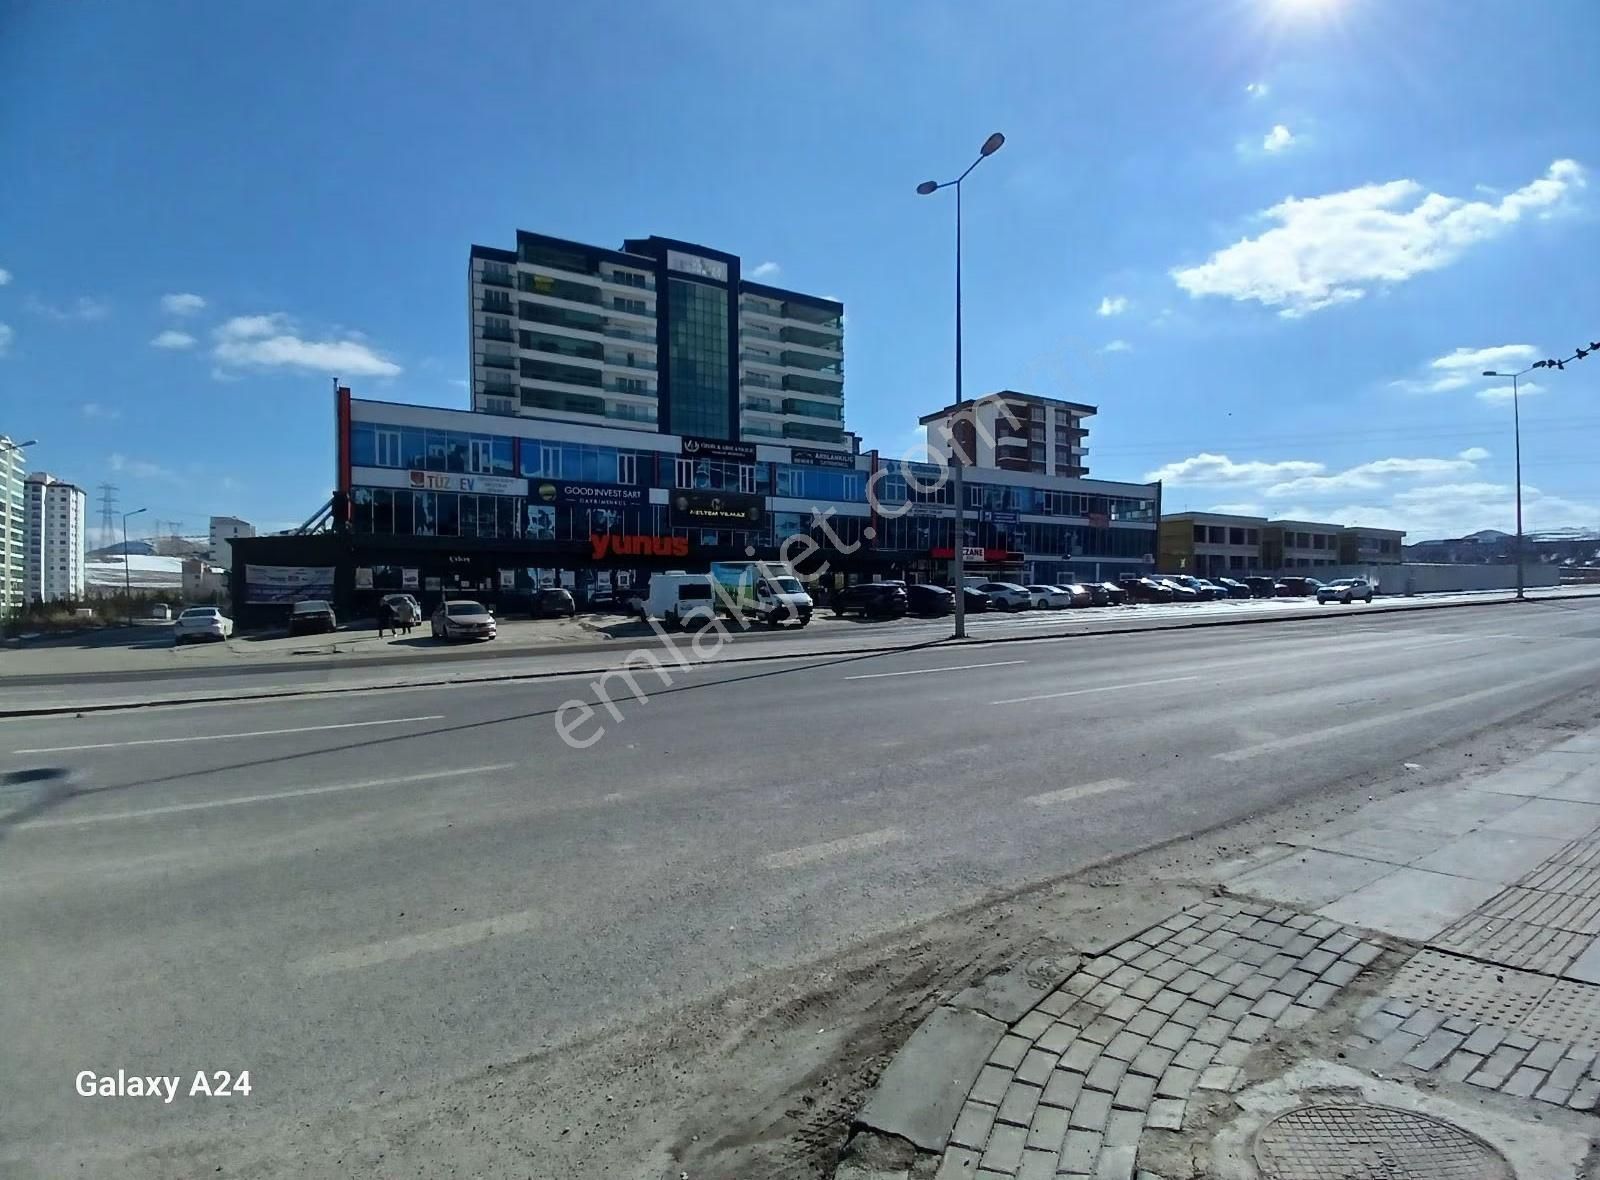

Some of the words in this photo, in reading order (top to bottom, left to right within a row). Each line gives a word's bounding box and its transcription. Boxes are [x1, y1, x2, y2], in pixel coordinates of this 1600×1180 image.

[460, 478, 474, 490] EV
[564, 486, 594, 496] GOOD
[594, 488, 622, 498] INVEST
[591, 533, 689, 561] yunus
